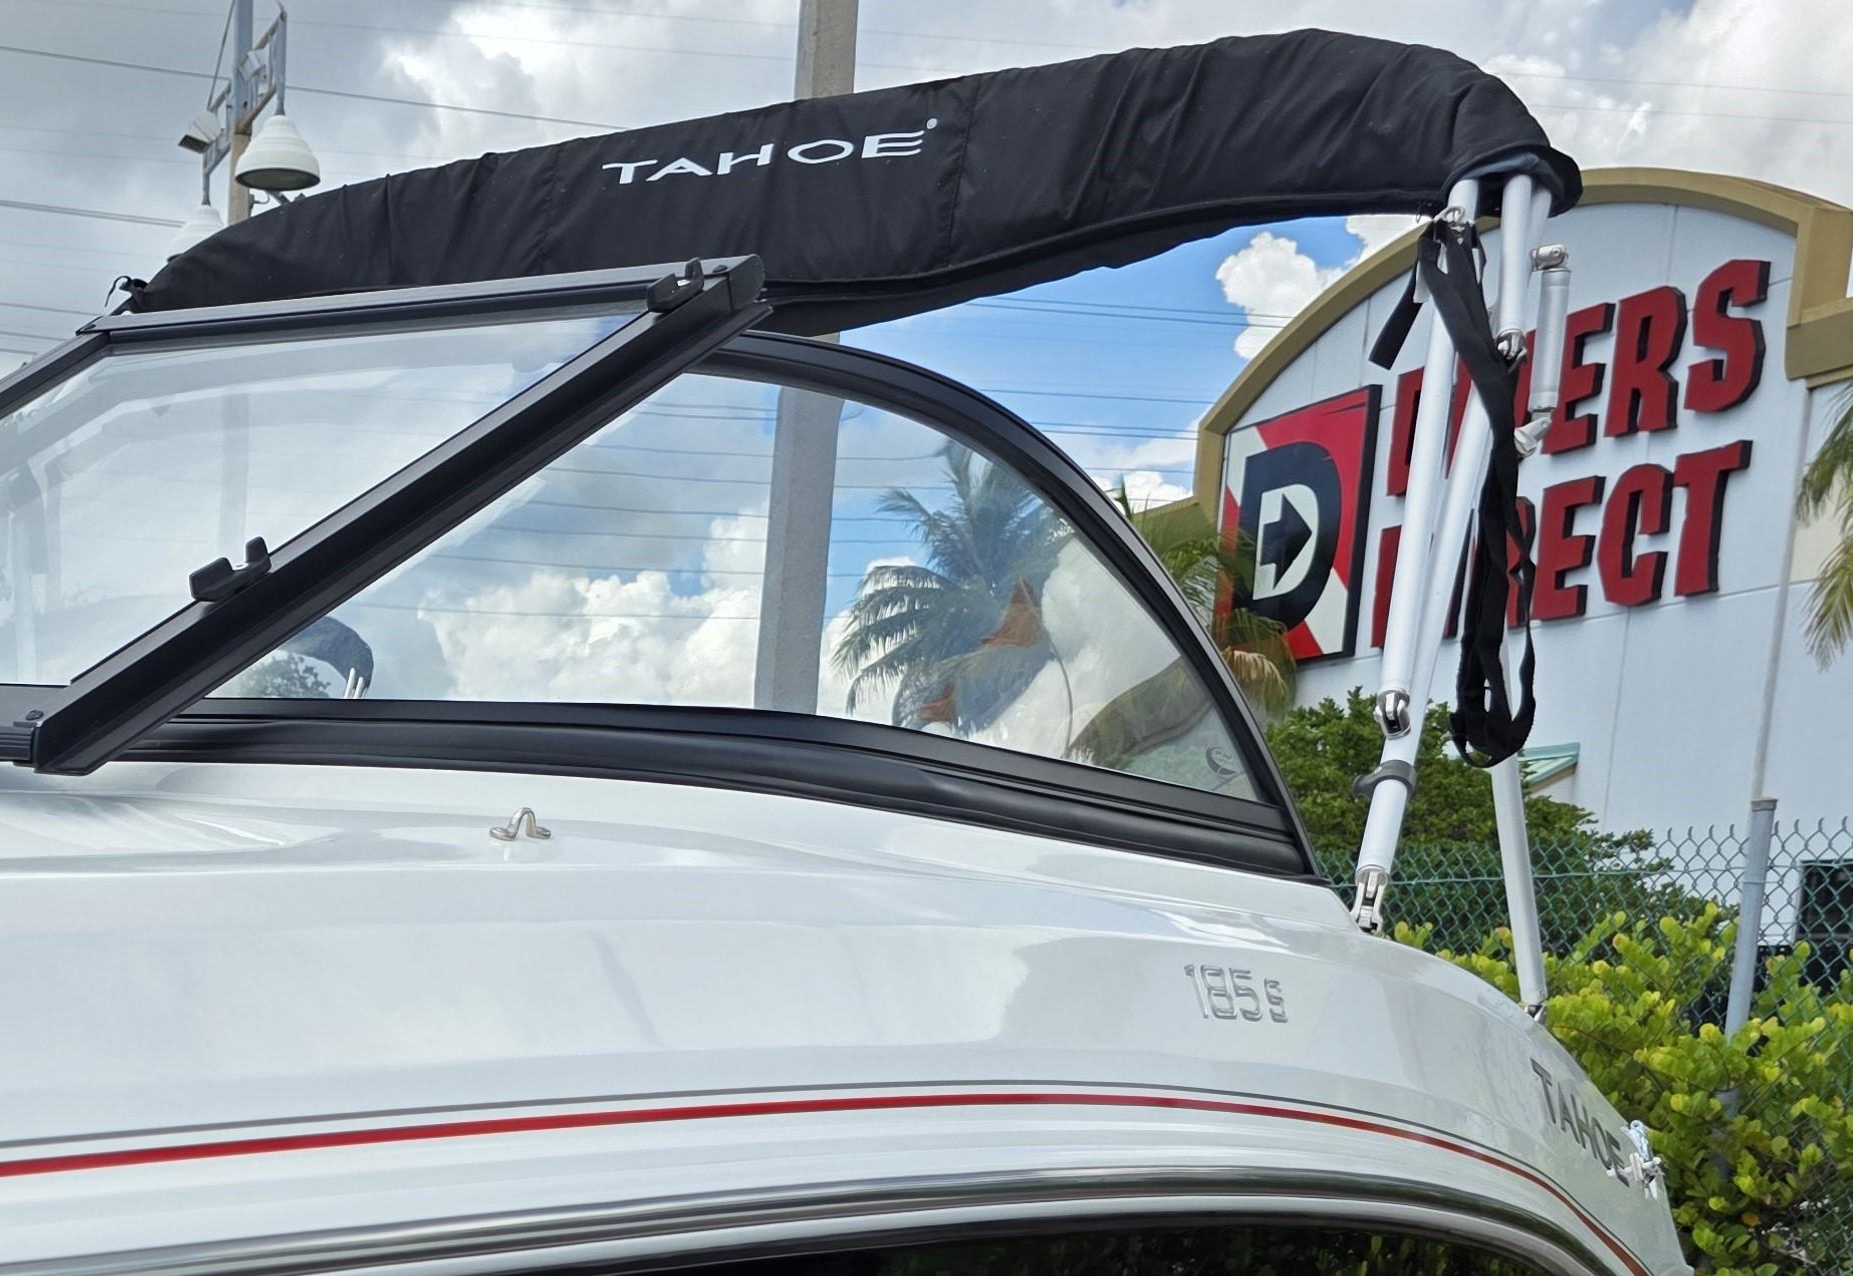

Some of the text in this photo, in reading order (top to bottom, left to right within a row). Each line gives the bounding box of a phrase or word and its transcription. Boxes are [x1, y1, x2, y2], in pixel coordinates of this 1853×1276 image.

[602, 129, 925, 185] TAHOE
[1387, 259, 1771, 497] DERS
[1530, 1057, 1630, 1188] TAHOE
